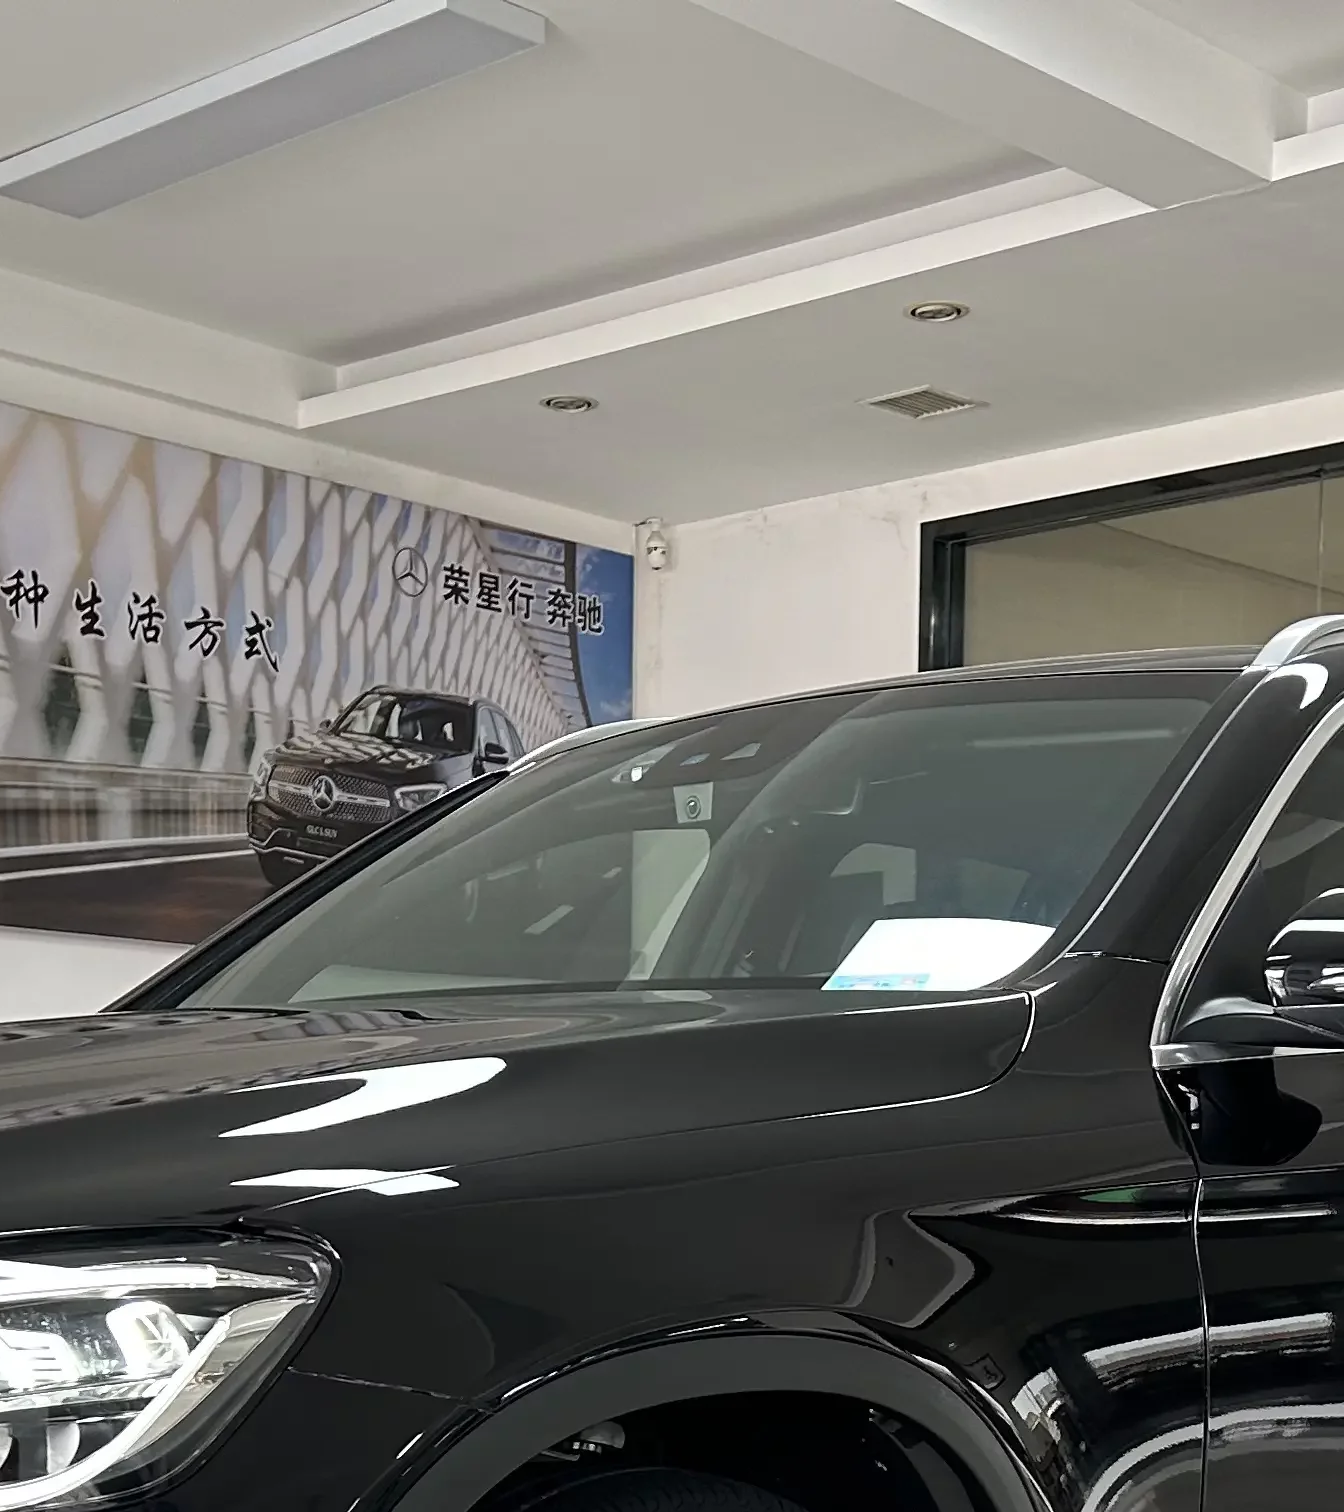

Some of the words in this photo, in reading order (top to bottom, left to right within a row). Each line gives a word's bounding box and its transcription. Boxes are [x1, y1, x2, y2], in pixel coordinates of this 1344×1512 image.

[442, 562, 535, 620] 荣星行
[545, 587, 605, 635] 奔驰
